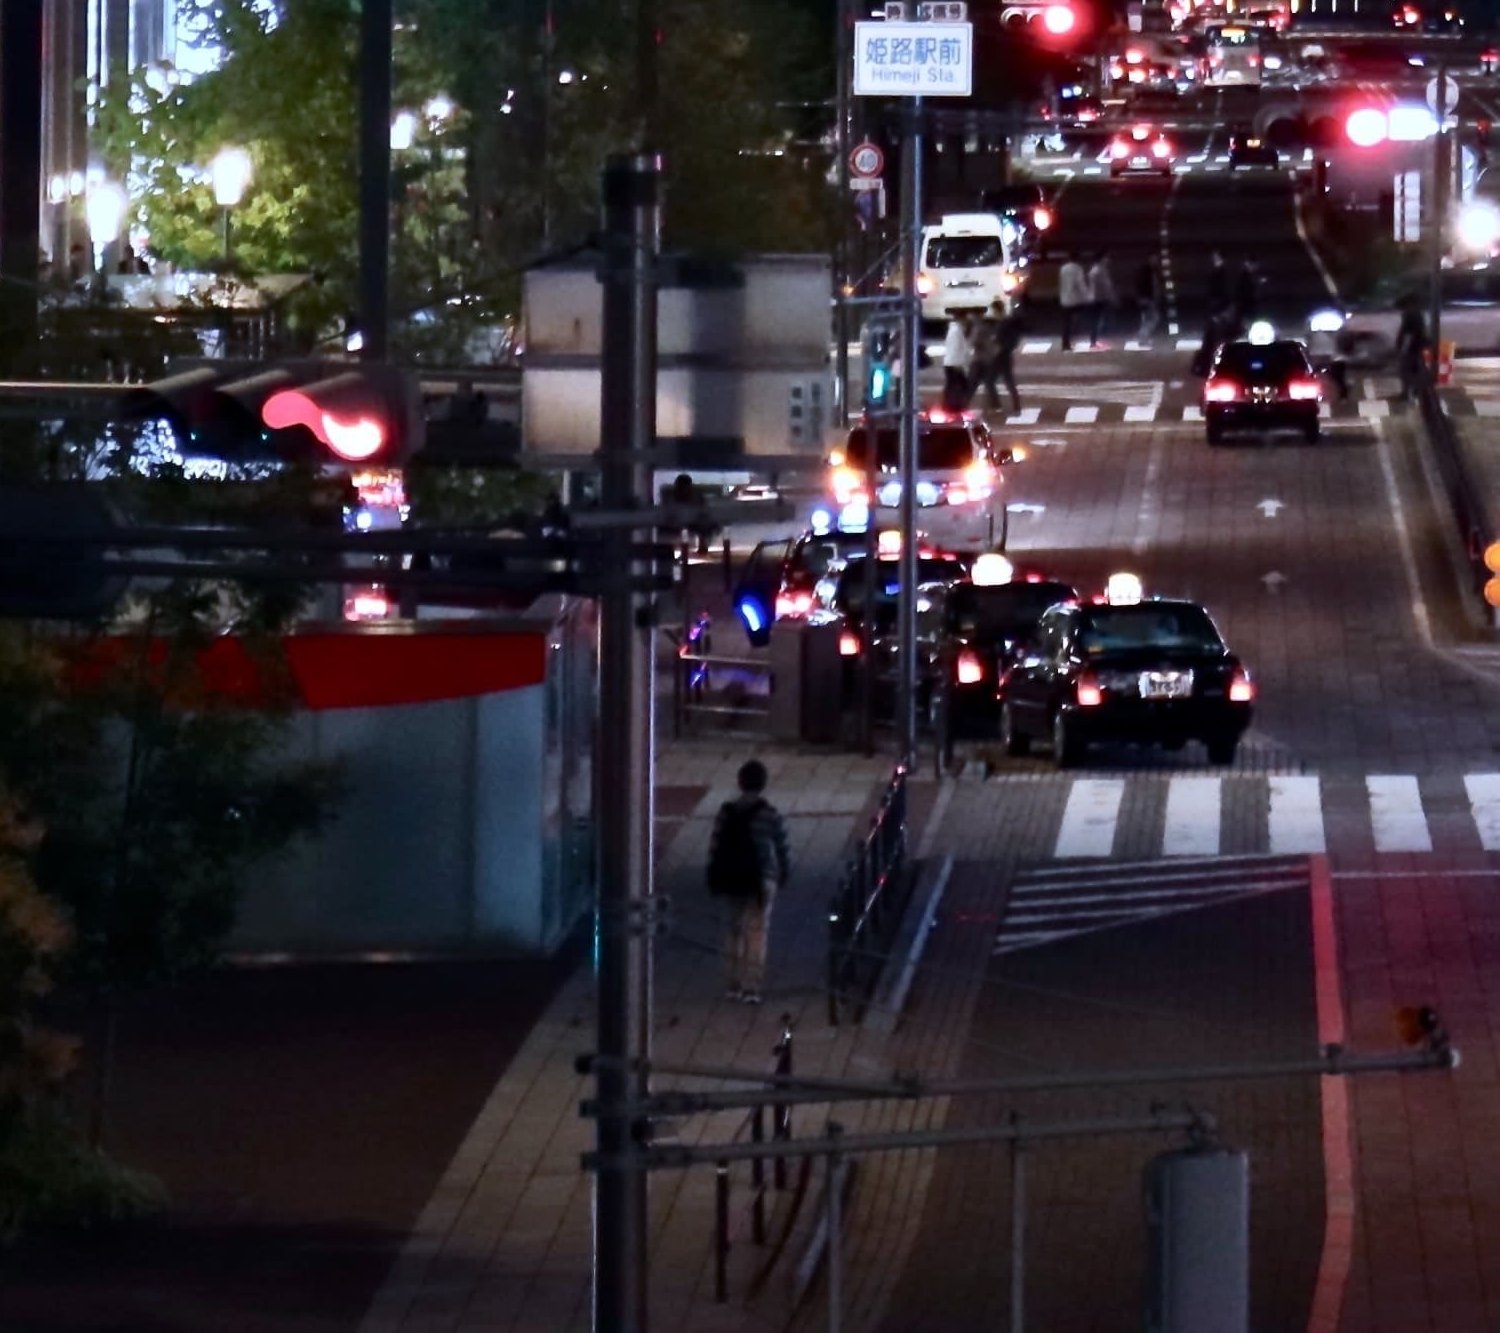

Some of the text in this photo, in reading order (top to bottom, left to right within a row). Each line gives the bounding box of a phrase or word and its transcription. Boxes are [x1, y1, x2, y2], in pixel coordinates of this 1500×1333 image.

[865, 36, 961, 66] 姫路駅前
[871, 67, 921, 83] Himeji
